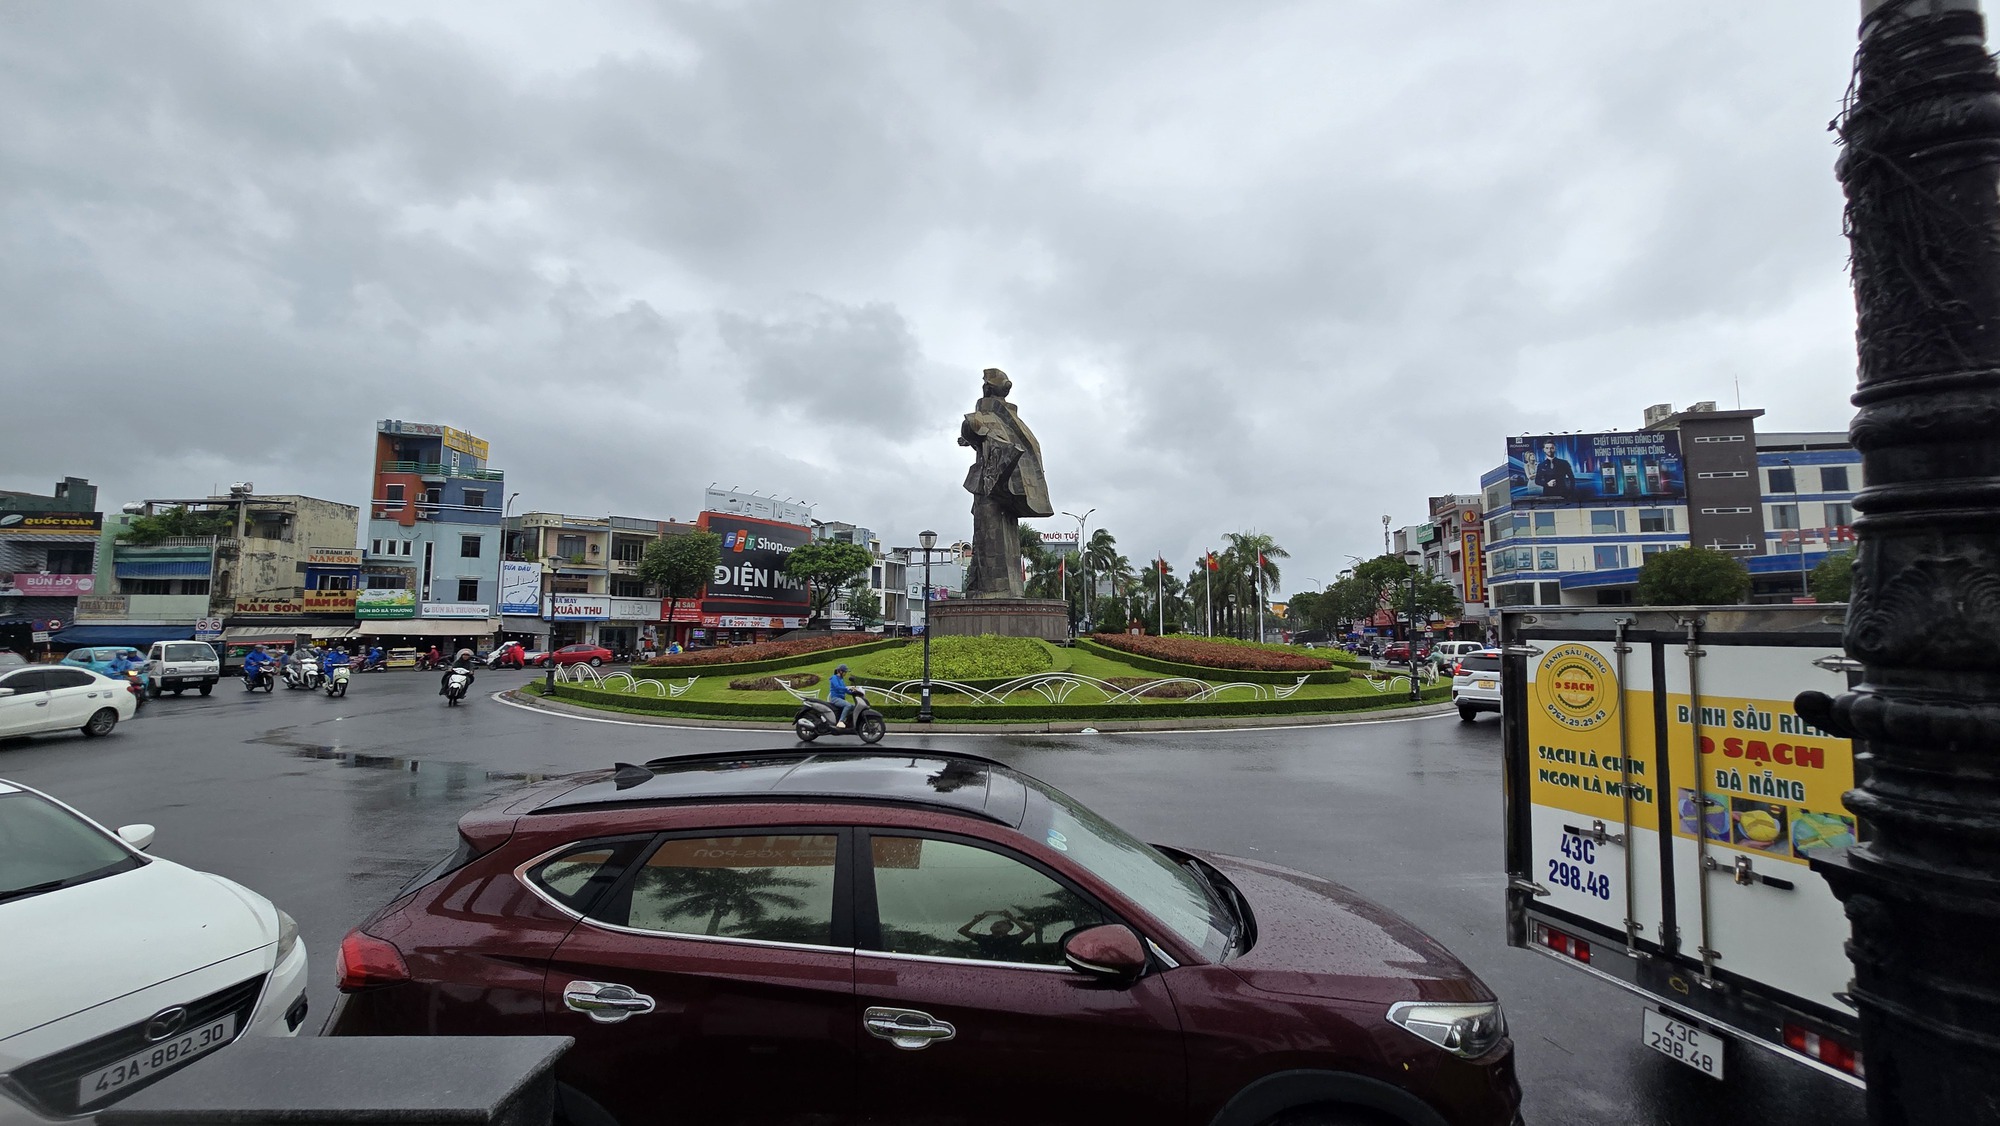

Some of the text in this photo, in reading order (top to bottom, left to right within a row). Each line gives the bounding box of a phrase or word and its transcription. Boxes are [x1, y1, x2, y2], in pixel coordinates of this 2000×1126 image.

[24, 517, 61, 526] QUỐC
[26, 575, 53, 586] BÚN
[714, 561, 768, 592] ĐIỆN
[237, 603, 269, 612] NAM
[305, 598, 331, 607] NAM
[554, 603, 602, 615] XUÂN THU
[1564, 682, 1595, 693] SẠCH
[1678, 705, 1726, 727] BNH
[1733, 704, 1771, 732] SẦU
[1539, 746, 1576, 764] SẠCH
[1580, 750, 1598, 768] LÀ
[1723, 737, 1824, 769] SẠCH
[1540, 769, 1579, 788] NGON
[1583, 775, 1602, 794] LÀ
[1716, 768, 1805, 802] ĐÀ NẴNG
[1561, 834, 1595, 865] 43C
[1549, 859, 1610, 900] 298.48
[1665, 1021, 1699, 1047] 43C
[94, 1022, 225, 1093] 43A-882.30
[1651, 1033, 1713, 1073] 298.48
